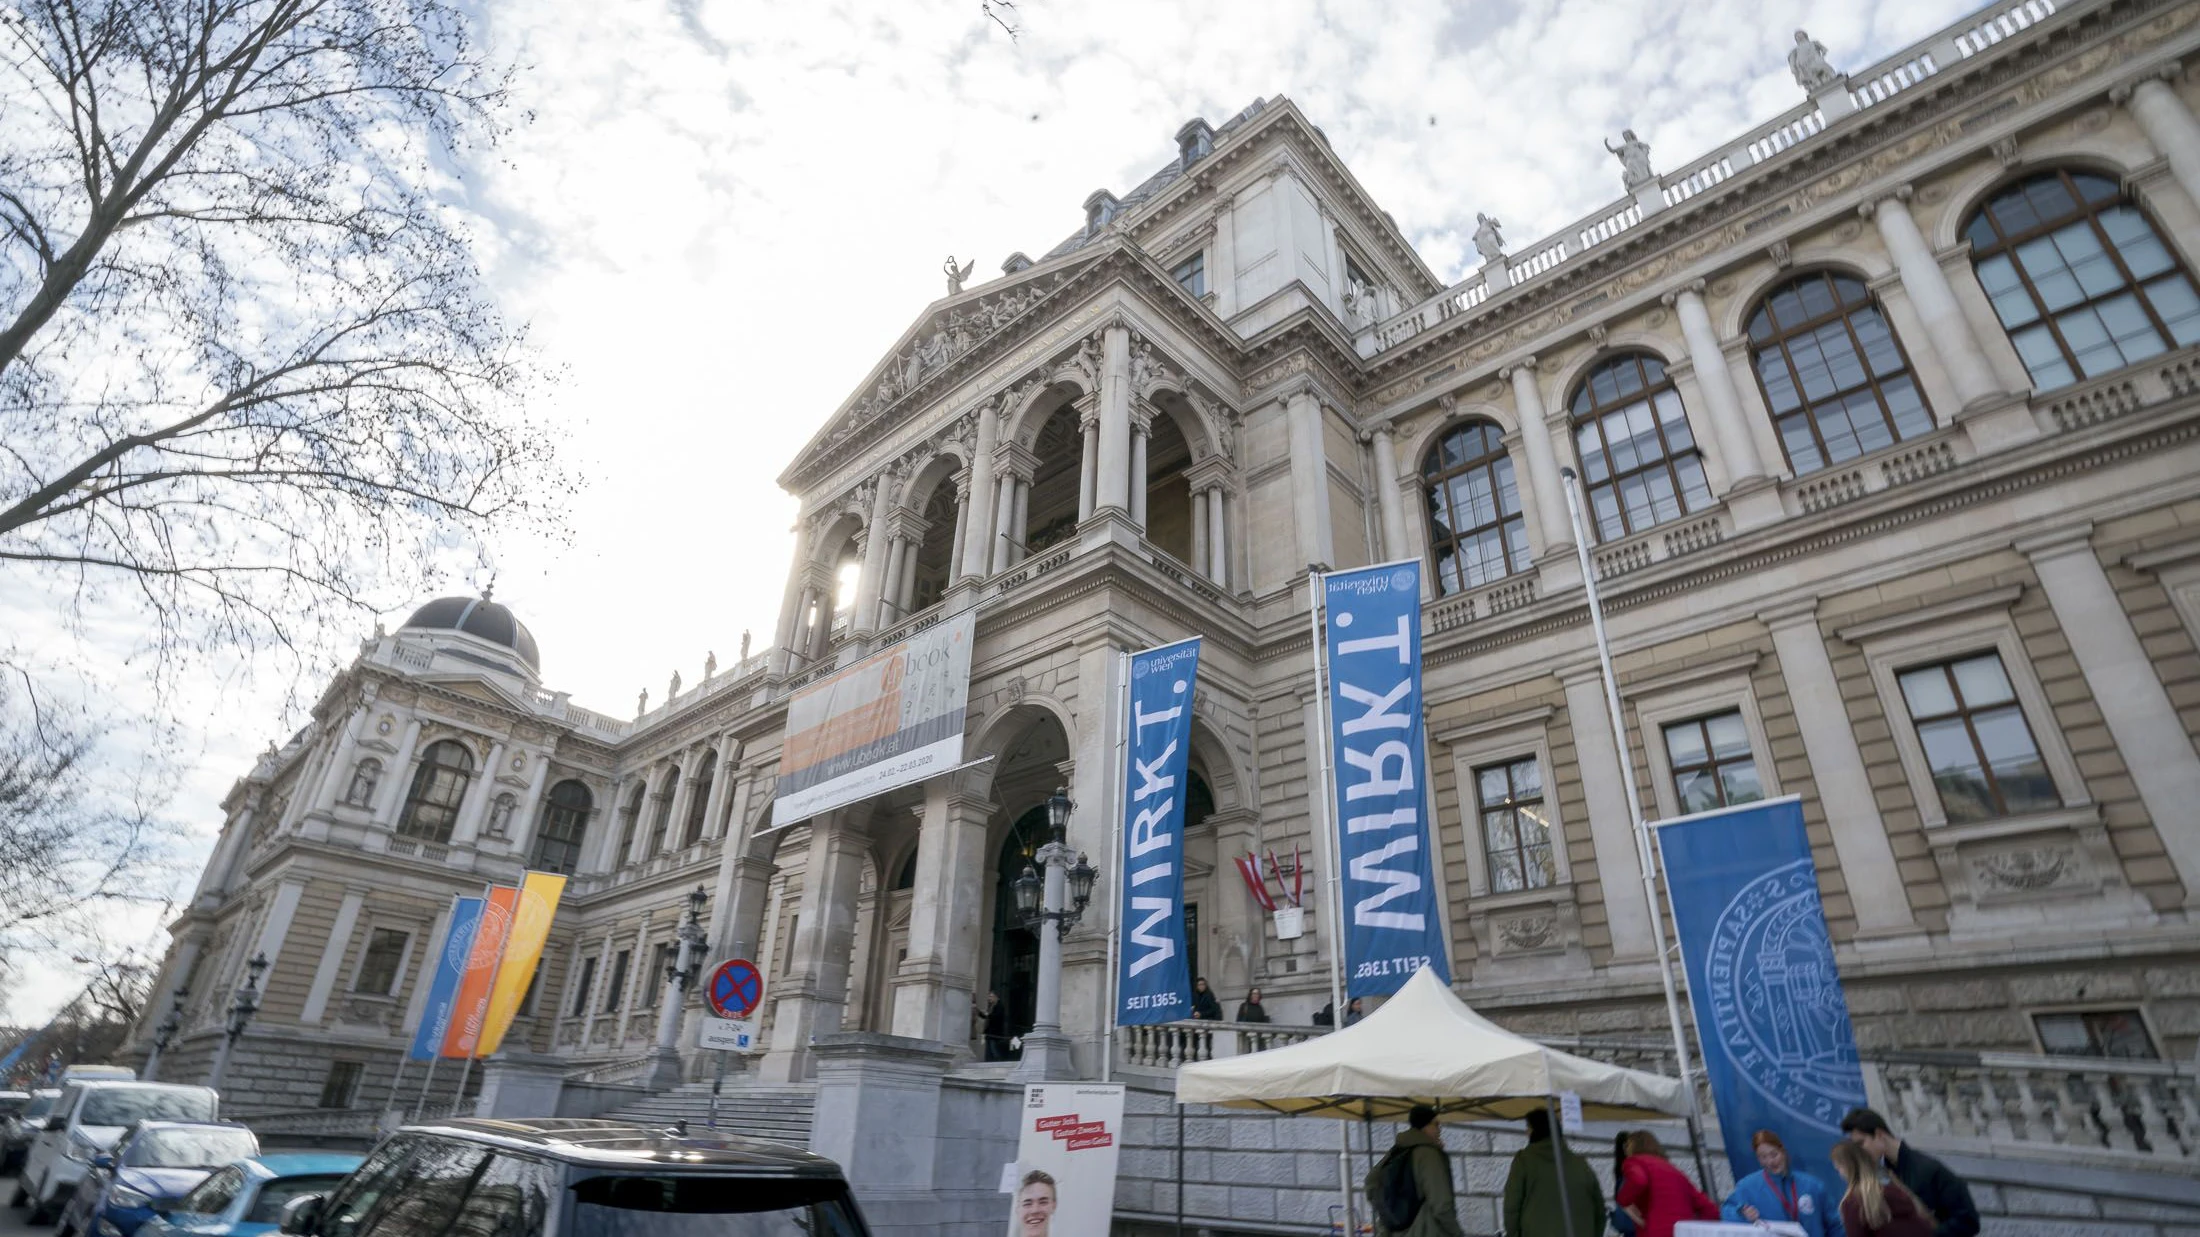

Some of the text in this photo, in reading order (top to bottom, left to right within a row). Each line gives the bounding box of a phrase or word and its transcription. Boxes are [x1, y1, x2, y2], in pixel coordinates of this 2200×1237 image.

[1150, 647, 1196, 667] universität
[1150, 661, 1174, 674] wien
[1129, 679, 1188, 978] WIRKT.
[1126, 991, 1183, 1010] SEIT 1365.
